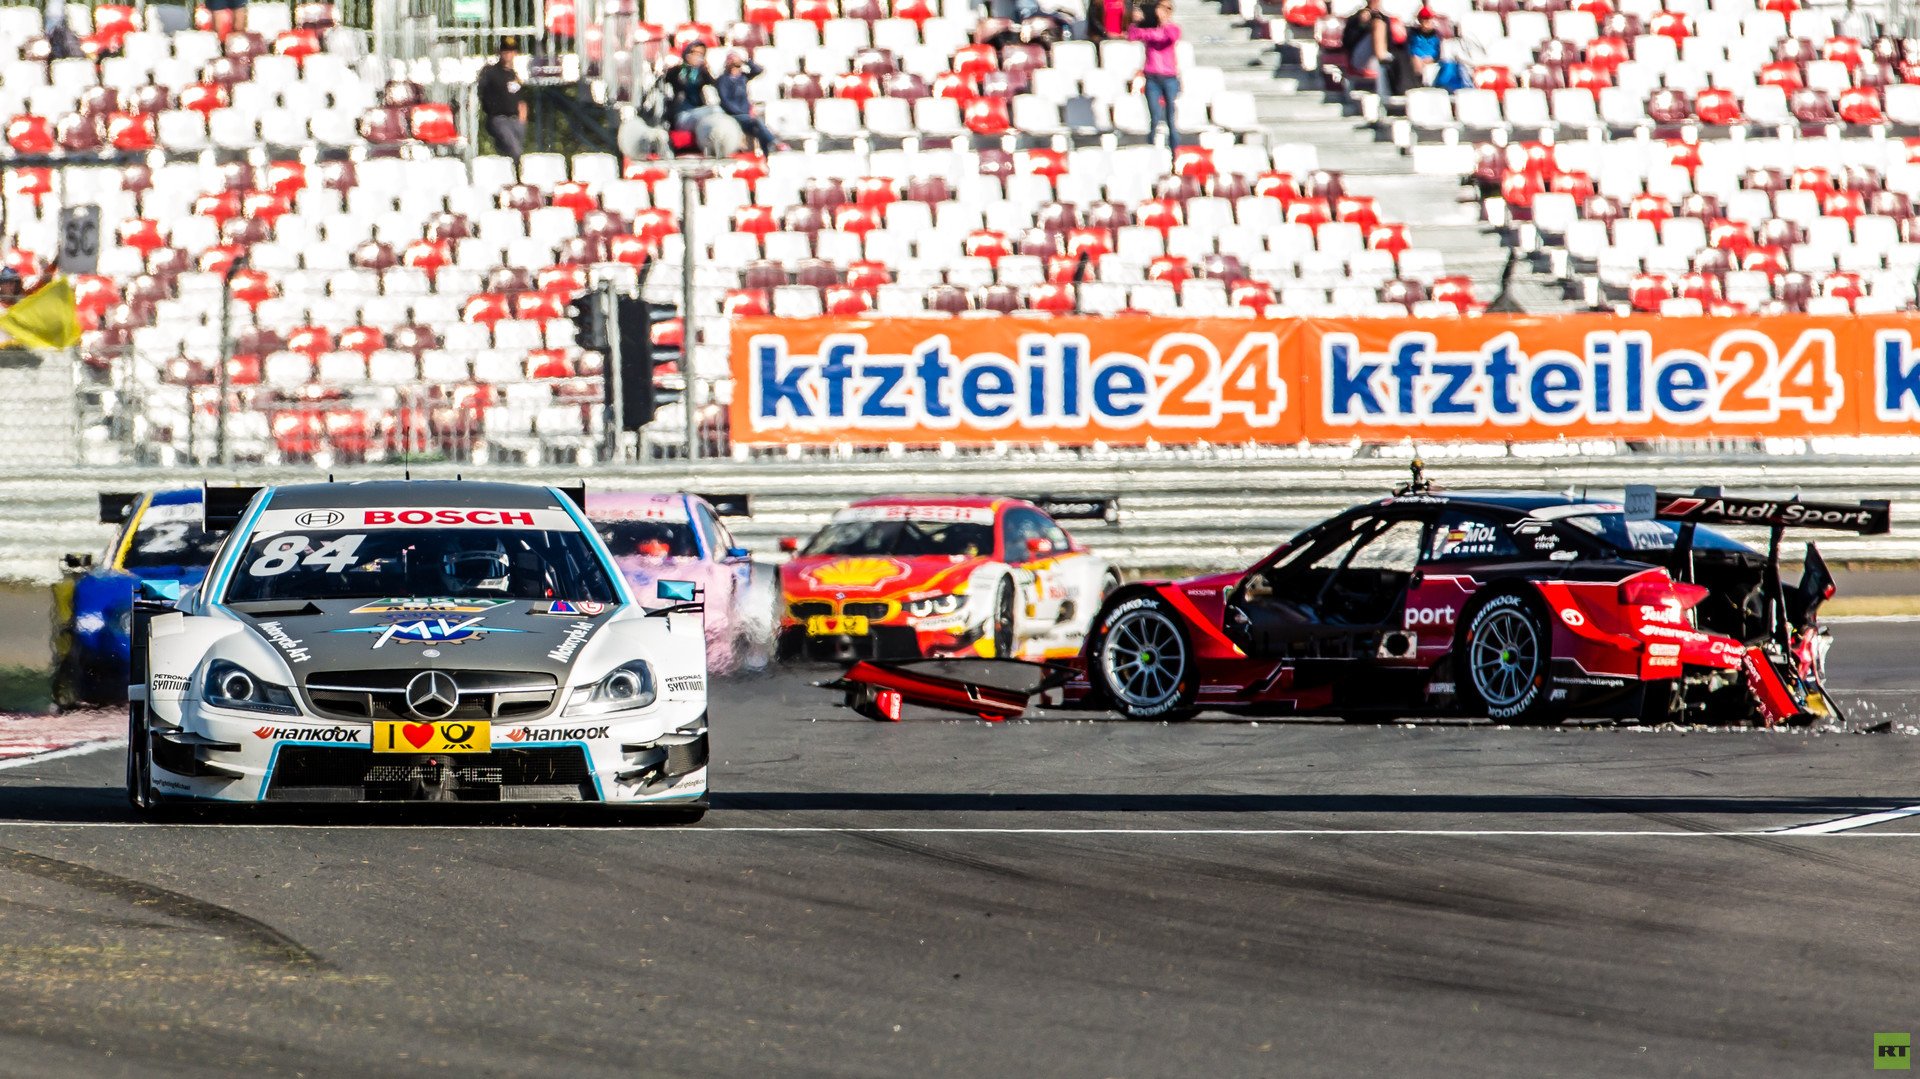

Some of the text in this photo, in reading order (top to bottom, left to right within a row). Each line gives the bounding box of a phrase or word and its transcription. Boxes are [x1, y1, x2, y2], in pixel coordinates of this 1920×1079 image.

[750, 333, 1287, 428] kfzteile24
[1322, 331, 1844, 424] kfzteile24
[363, 510, 535, 526] BOSCH
[1703, 499, 1872, 525] Audi Sport
[249, 534, 367, 577] 84
[372, 617, 486, 649] MV
[152, 680, 191, 691] SYNTIUM
[154, 673, 193, 682] PETRONAS
[665, 674, 702, 683] PETRONAS
